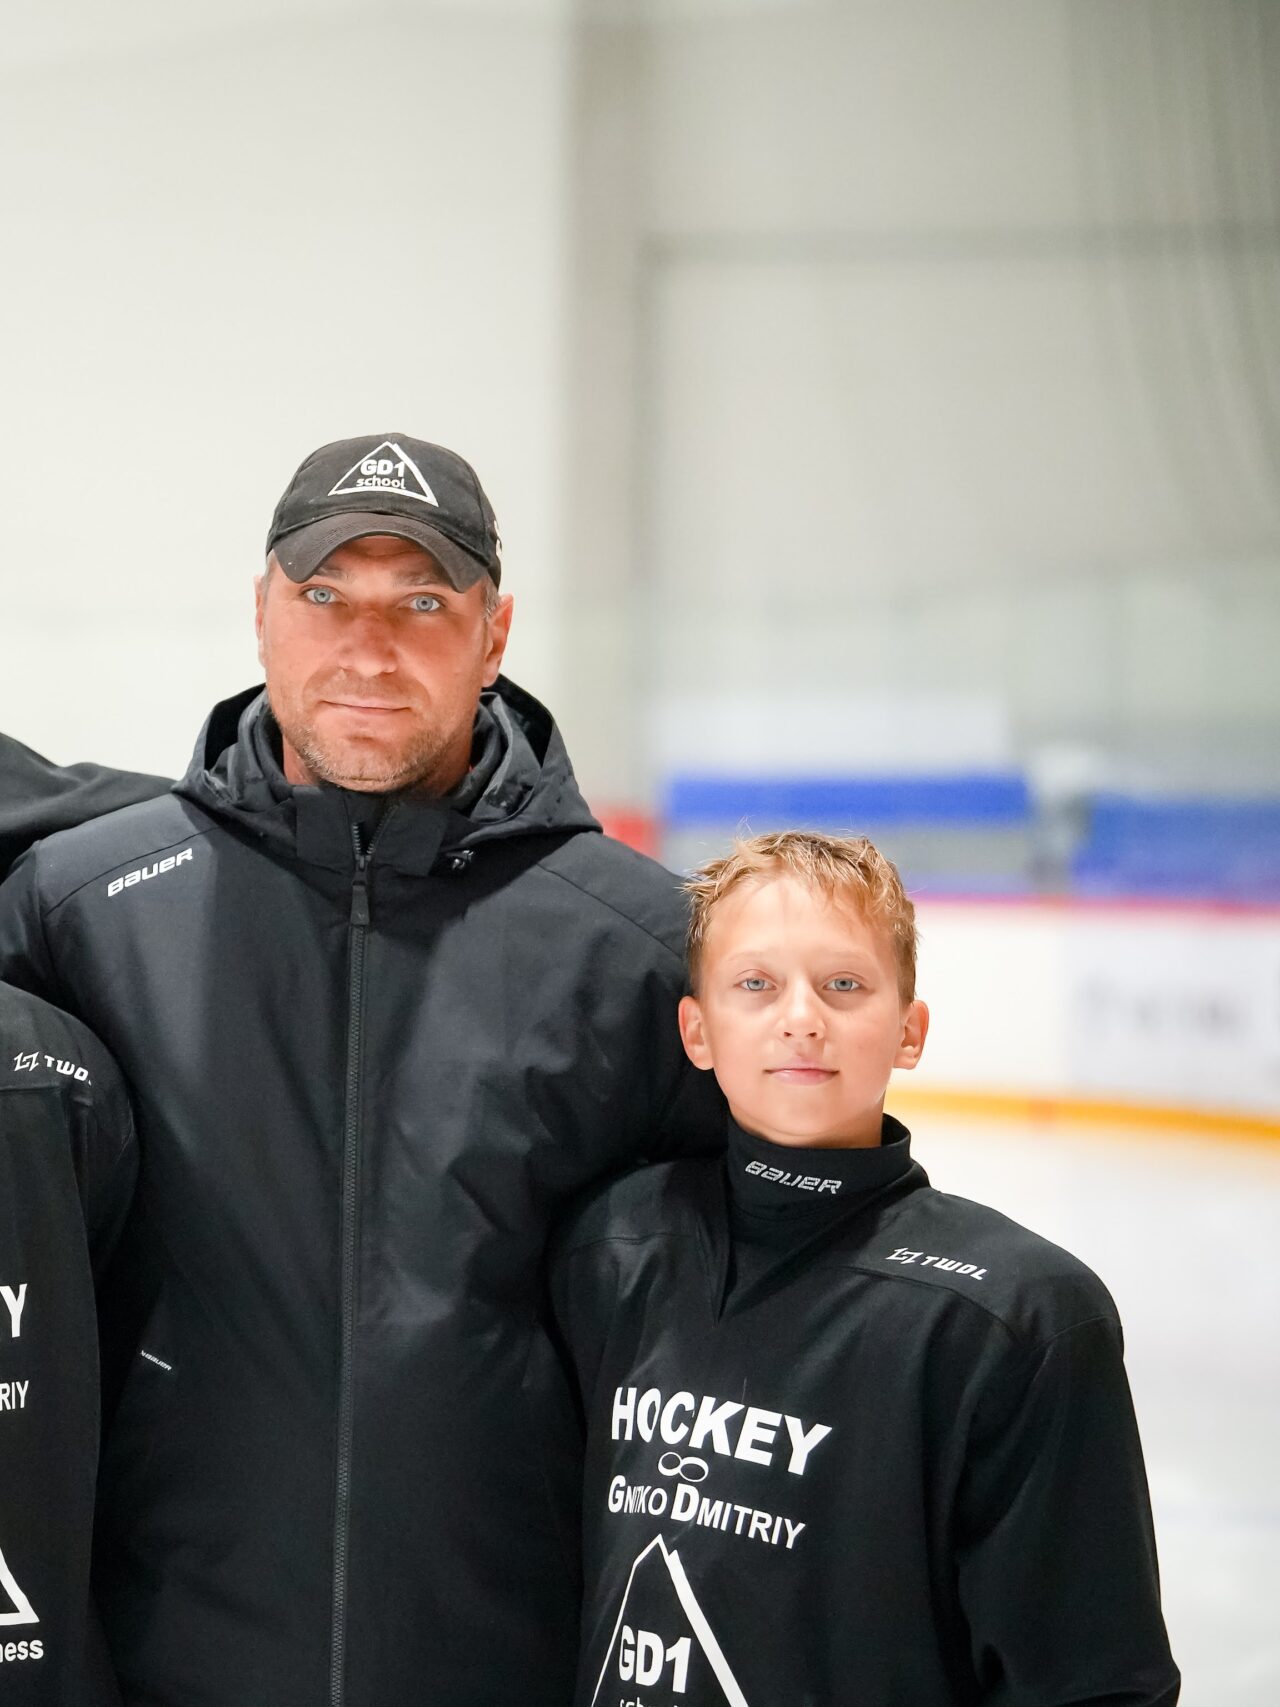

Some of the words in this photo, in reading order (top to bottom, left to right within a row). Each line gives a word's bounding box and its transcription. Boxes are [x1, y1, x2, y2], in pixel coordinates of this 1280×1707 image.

[356, 475, 407, 490] school
[360, 459, 405, 478] GD1
[107, 847, 193, 897] BAUER
[745, 1160, 843, 1194] BAUER
[920, 1255, 988, 1281] TWOL
[611, 1386, 833, 1476] HOCKEY
[670, 1482, 806, 1550] DMITRIY
[618, 1624, 692, 1694] GD1
